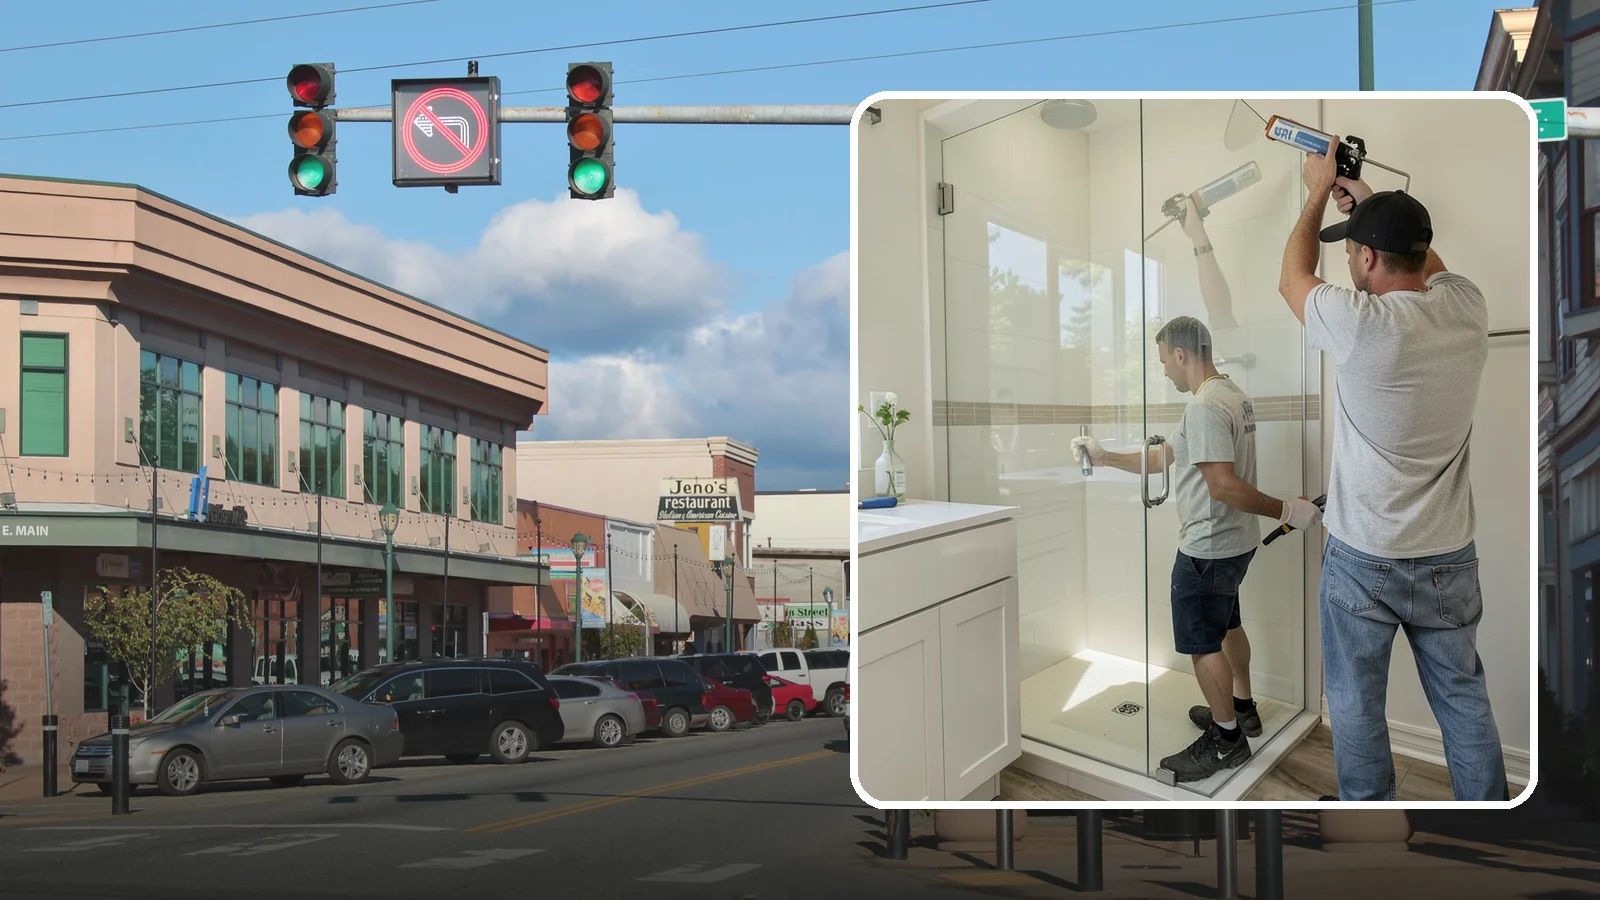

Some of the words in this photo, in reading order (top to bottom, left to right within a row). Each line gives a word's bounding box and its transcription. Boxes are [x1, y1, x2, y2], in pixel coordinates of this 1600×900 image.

[669, 480, 728, 495] Jeno's
[664, 496, 731, 509] restaurant
[658, 510, 681, 519] Italian
[686, 510, 714, 519] American
[715, 510, 738, 519] Cuisine
[2, 525, 13, 536] E.
[15, 525, 49, 536] MAIN
[797, 607, 828, 616] Street
